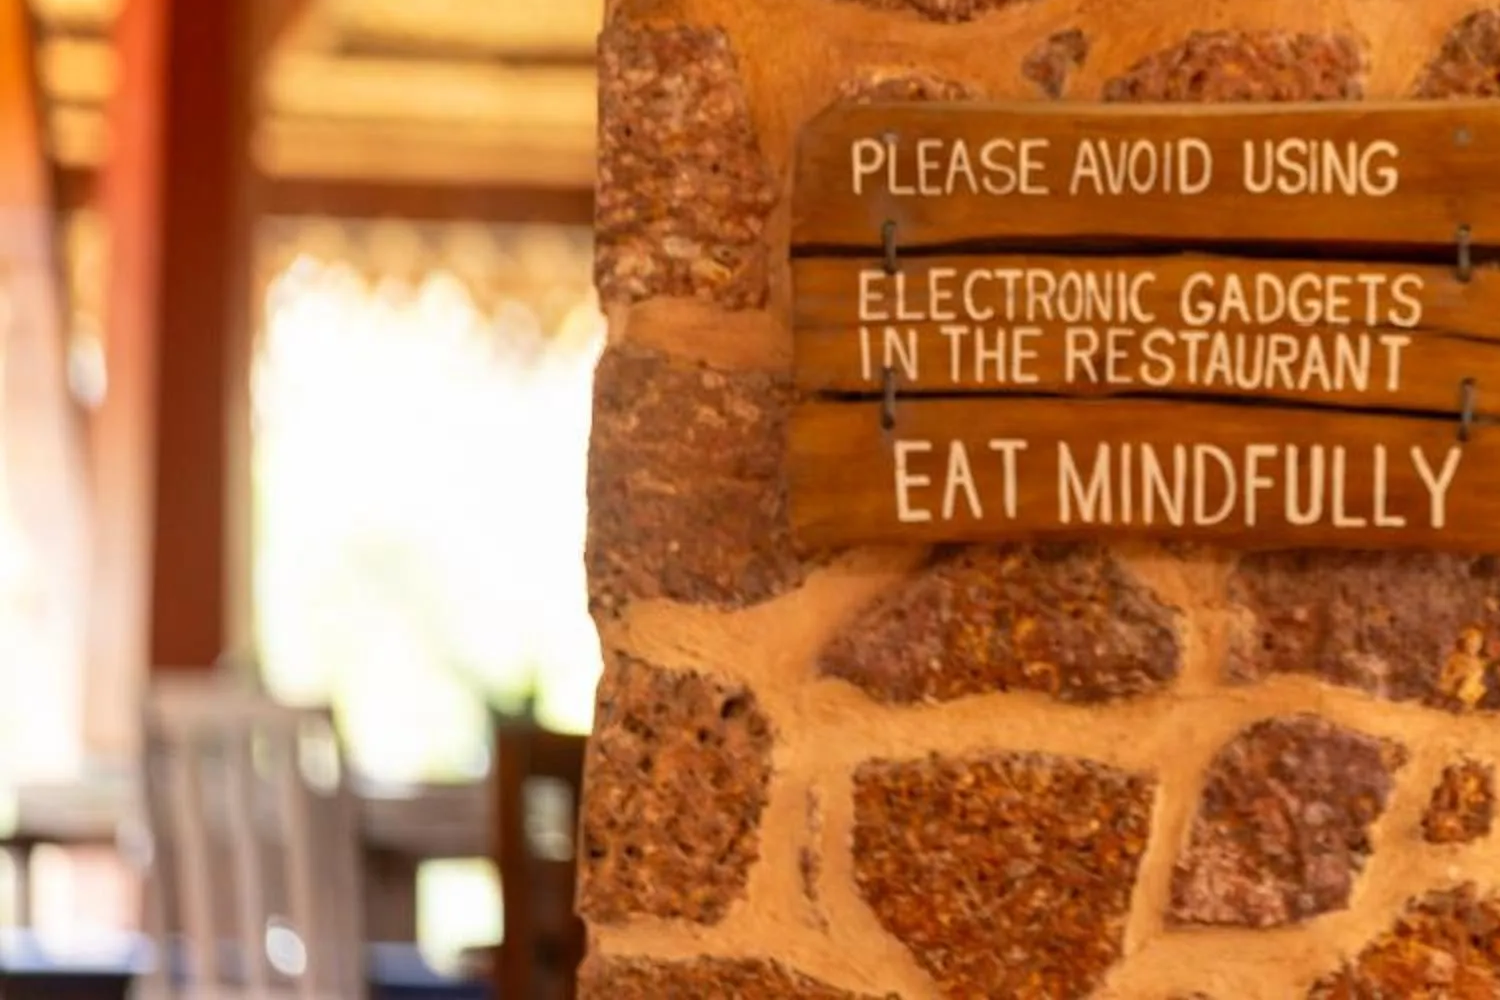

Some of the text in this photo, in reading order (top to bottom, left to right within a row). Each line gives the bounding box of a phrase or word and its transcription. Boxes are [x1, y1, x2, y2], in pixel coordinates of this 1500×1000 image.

[852, 137, 1400, 198] PLEASE AVOID USING
[857, 269, 1424, 328] ELECTRONIC GADGETS
[859, 327, 1413, 392] IN THE RESTAURANT
[894, 439, 1461, 529] EAT MINDFULLY
